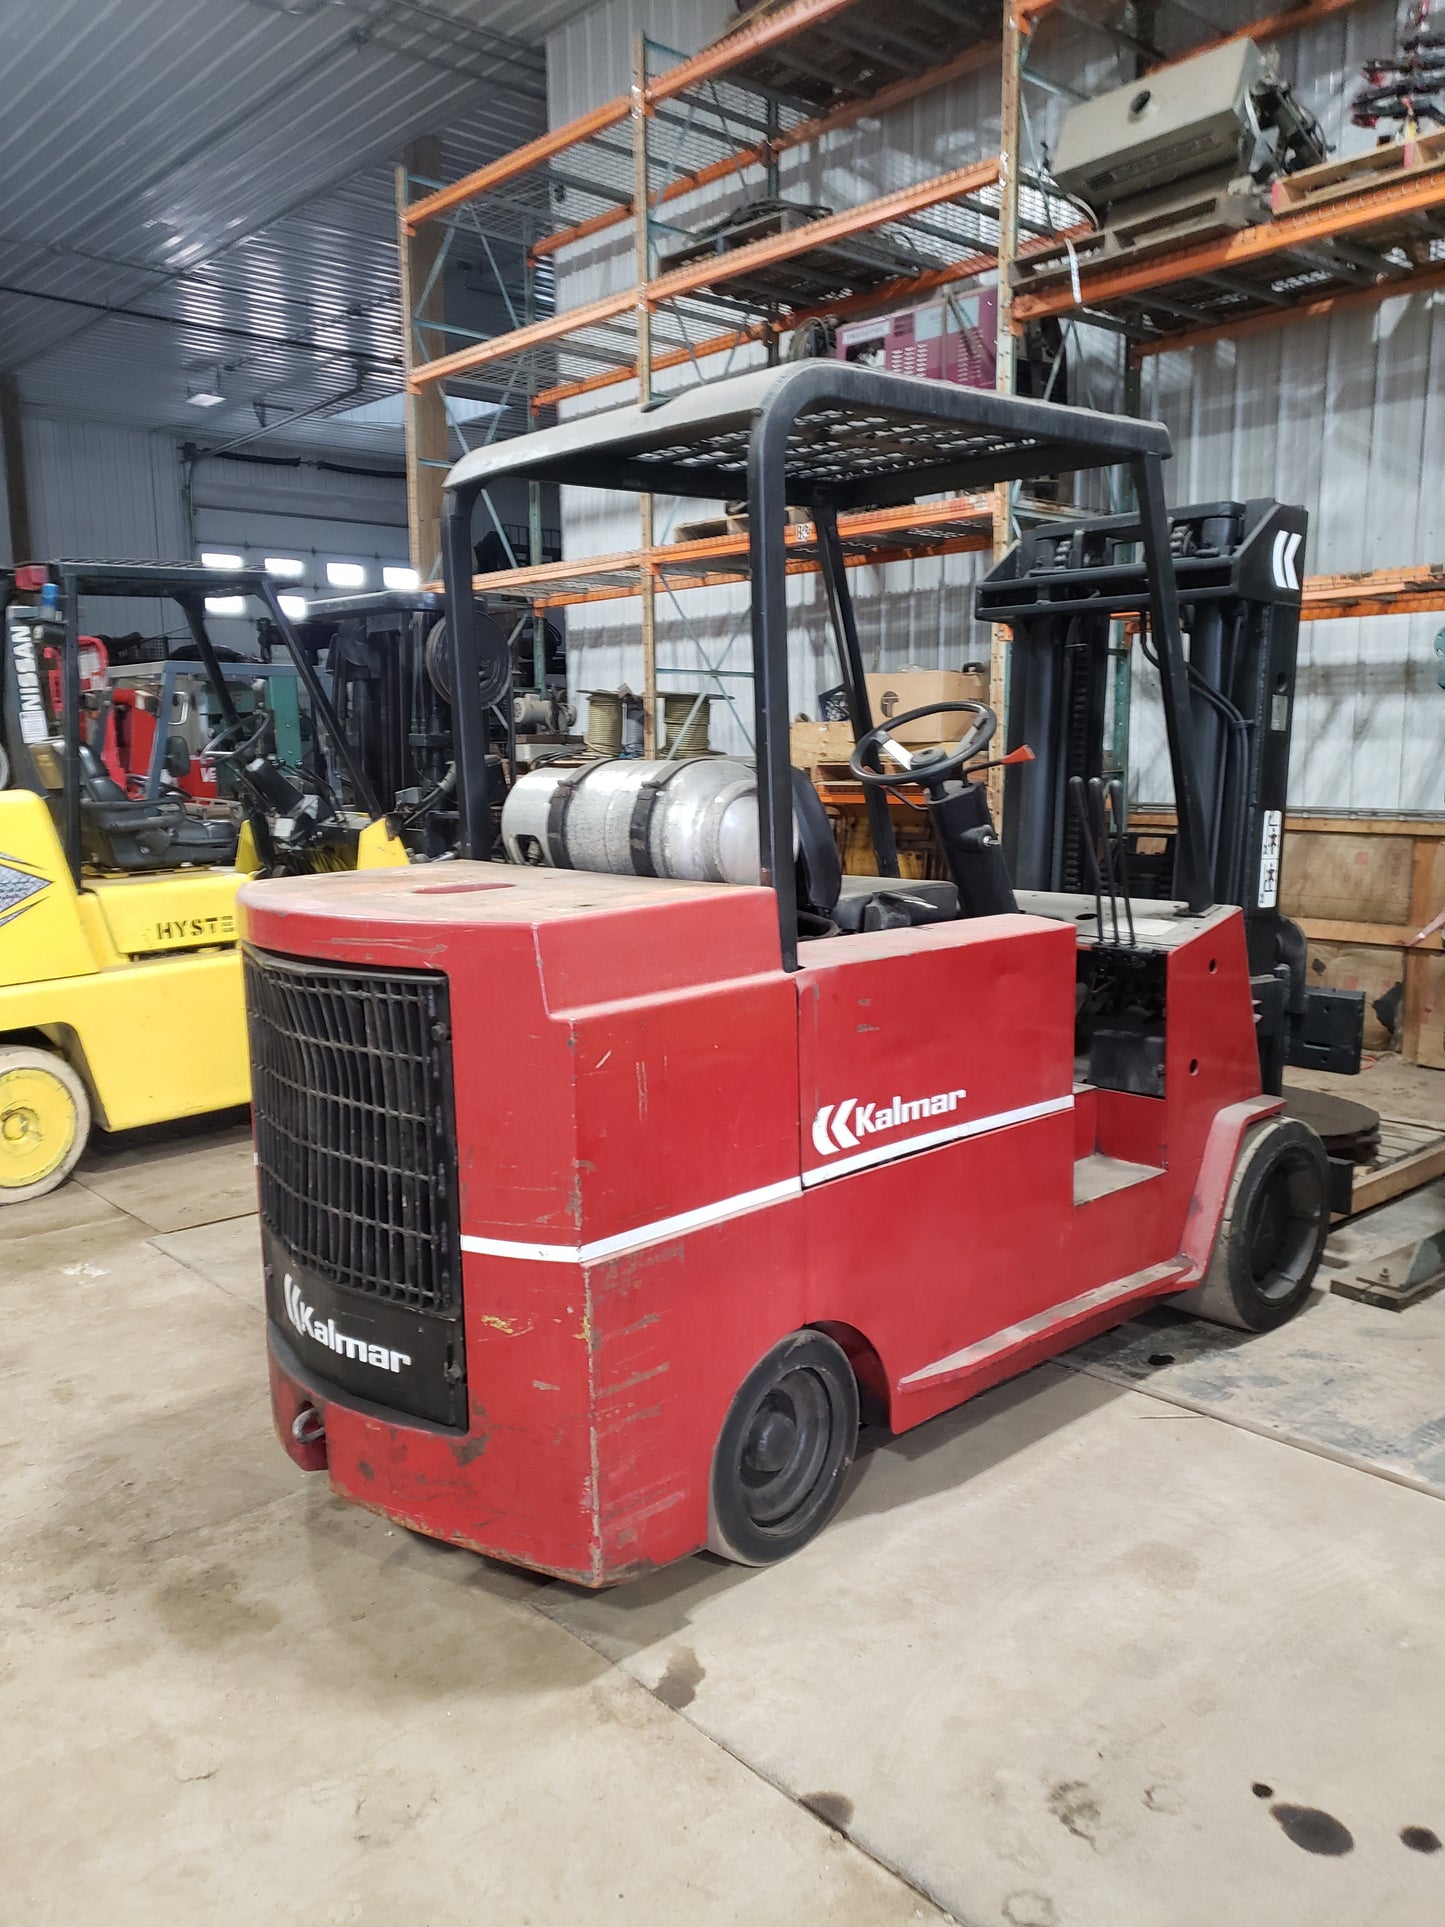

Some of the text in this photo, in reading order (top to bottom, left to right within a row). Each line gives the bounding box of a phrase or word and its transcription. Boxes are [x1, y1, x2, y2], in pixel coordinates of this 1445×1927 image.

[10, 625, 42, 711] NISSAN
[855, 1089, 967, 1137] Kalmar
[300, 1301, 412, 1374] Kalmar
